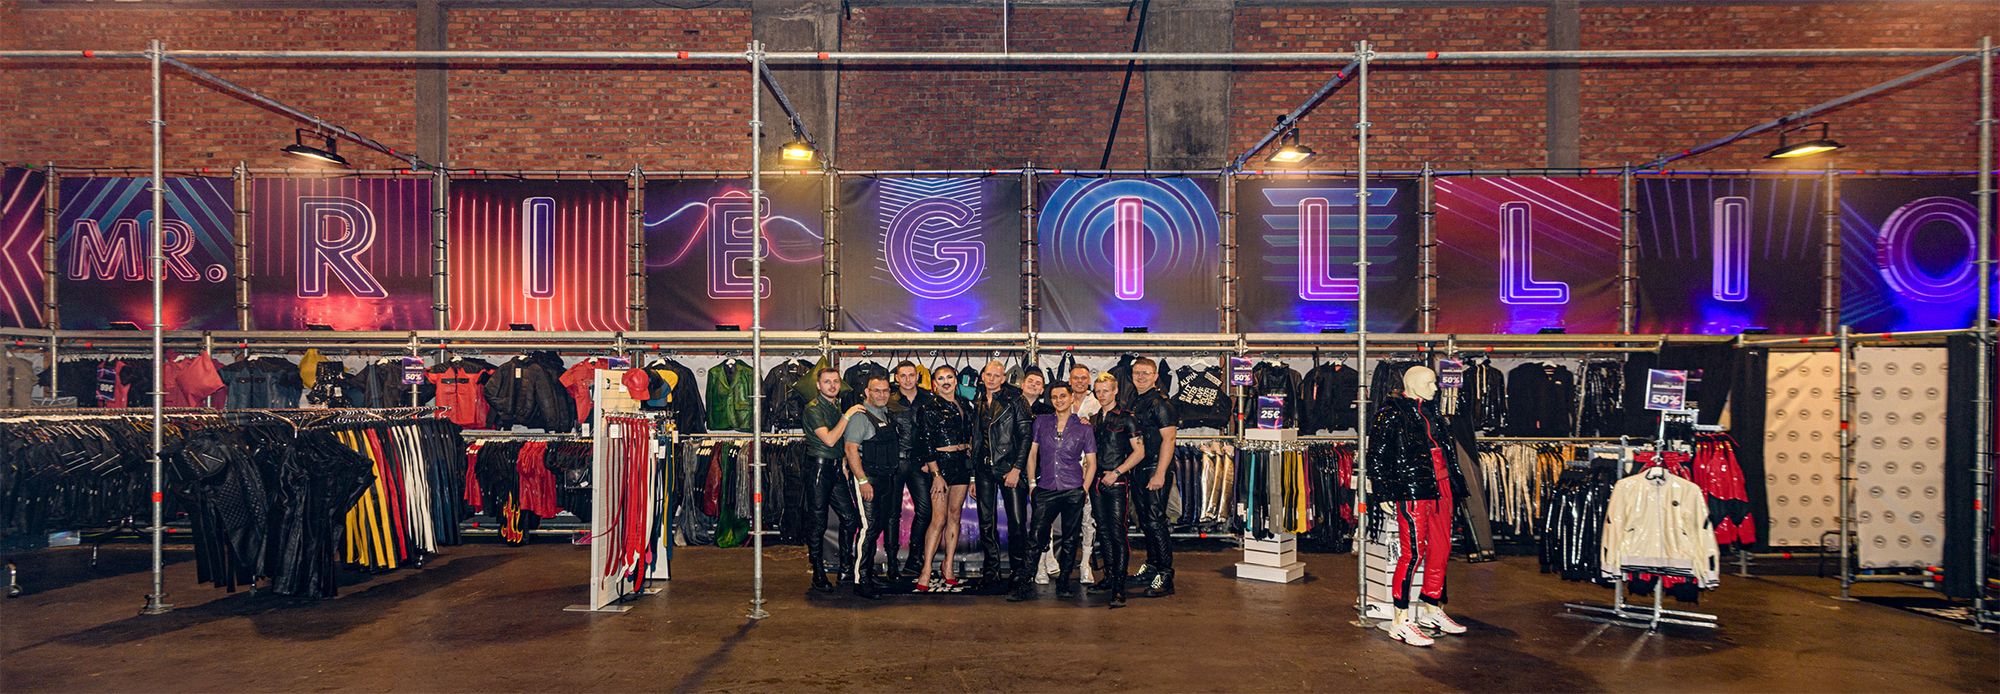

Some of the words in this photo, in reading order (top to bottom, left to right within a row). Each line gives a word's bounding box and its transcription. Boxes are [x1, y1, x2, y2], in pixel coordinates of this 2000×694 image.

[68, 218, 228, 283] MR.
[1180, 372, 1198, 386] ALPHA
[1442, 376, 1460, 384] 50%
[1651, 394, 1681, 405] 50%
[1260, 410, 1280, 419] 25€
